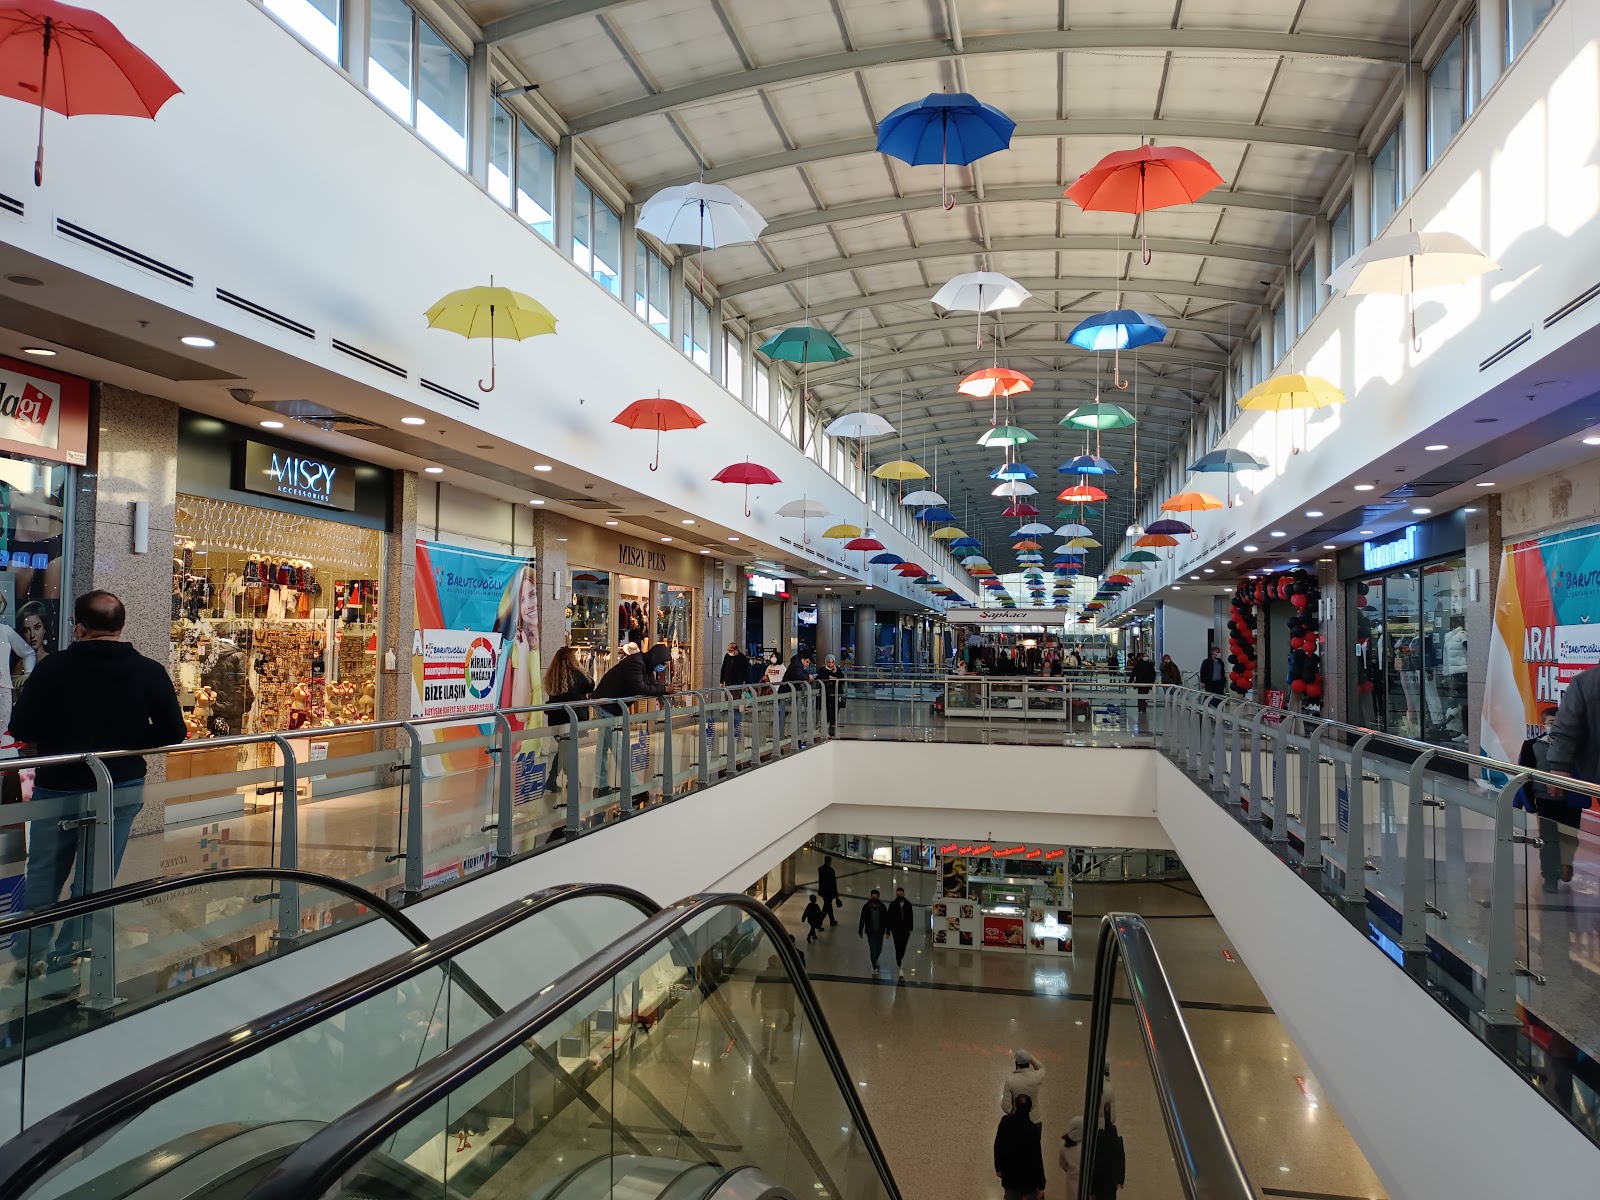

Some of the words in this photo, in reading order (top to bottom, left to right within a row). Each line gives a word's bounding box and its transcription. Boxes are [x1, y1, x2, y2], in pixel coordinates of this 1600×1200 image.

[269, 452, 337, 494] MISSY
[278, 486, 329, 501] ACCESSORIES
[618, 544, 646, 568] MISSY
[648, 551, 666, 572] PLUS
[470, 655, 492, 669] KİRALIK
[471, 669, 491, 681] MAĞAZA
[425, 683, 443, 701] BİZE
[443, 684, 466, 702] ULAŞIN
